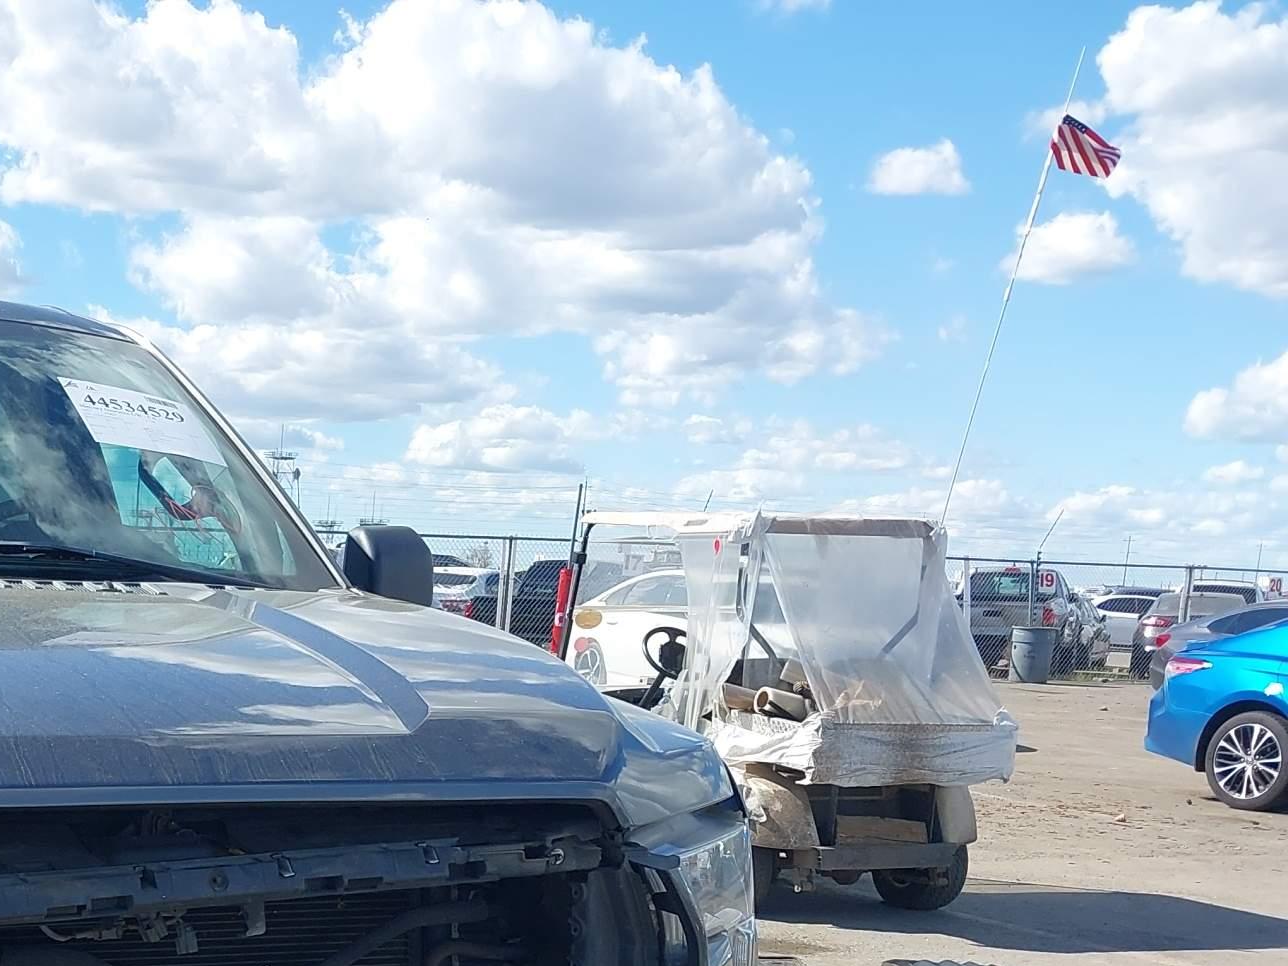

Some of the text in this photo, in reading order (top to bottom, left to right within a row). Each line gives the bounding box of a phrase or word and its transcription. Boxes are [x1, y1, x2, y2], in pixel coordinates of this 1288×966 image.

[83, 394, 185, 422] 44534529
[1040, 573, 1054, 587] 19
[1270, 578, 1282, 592] 20
